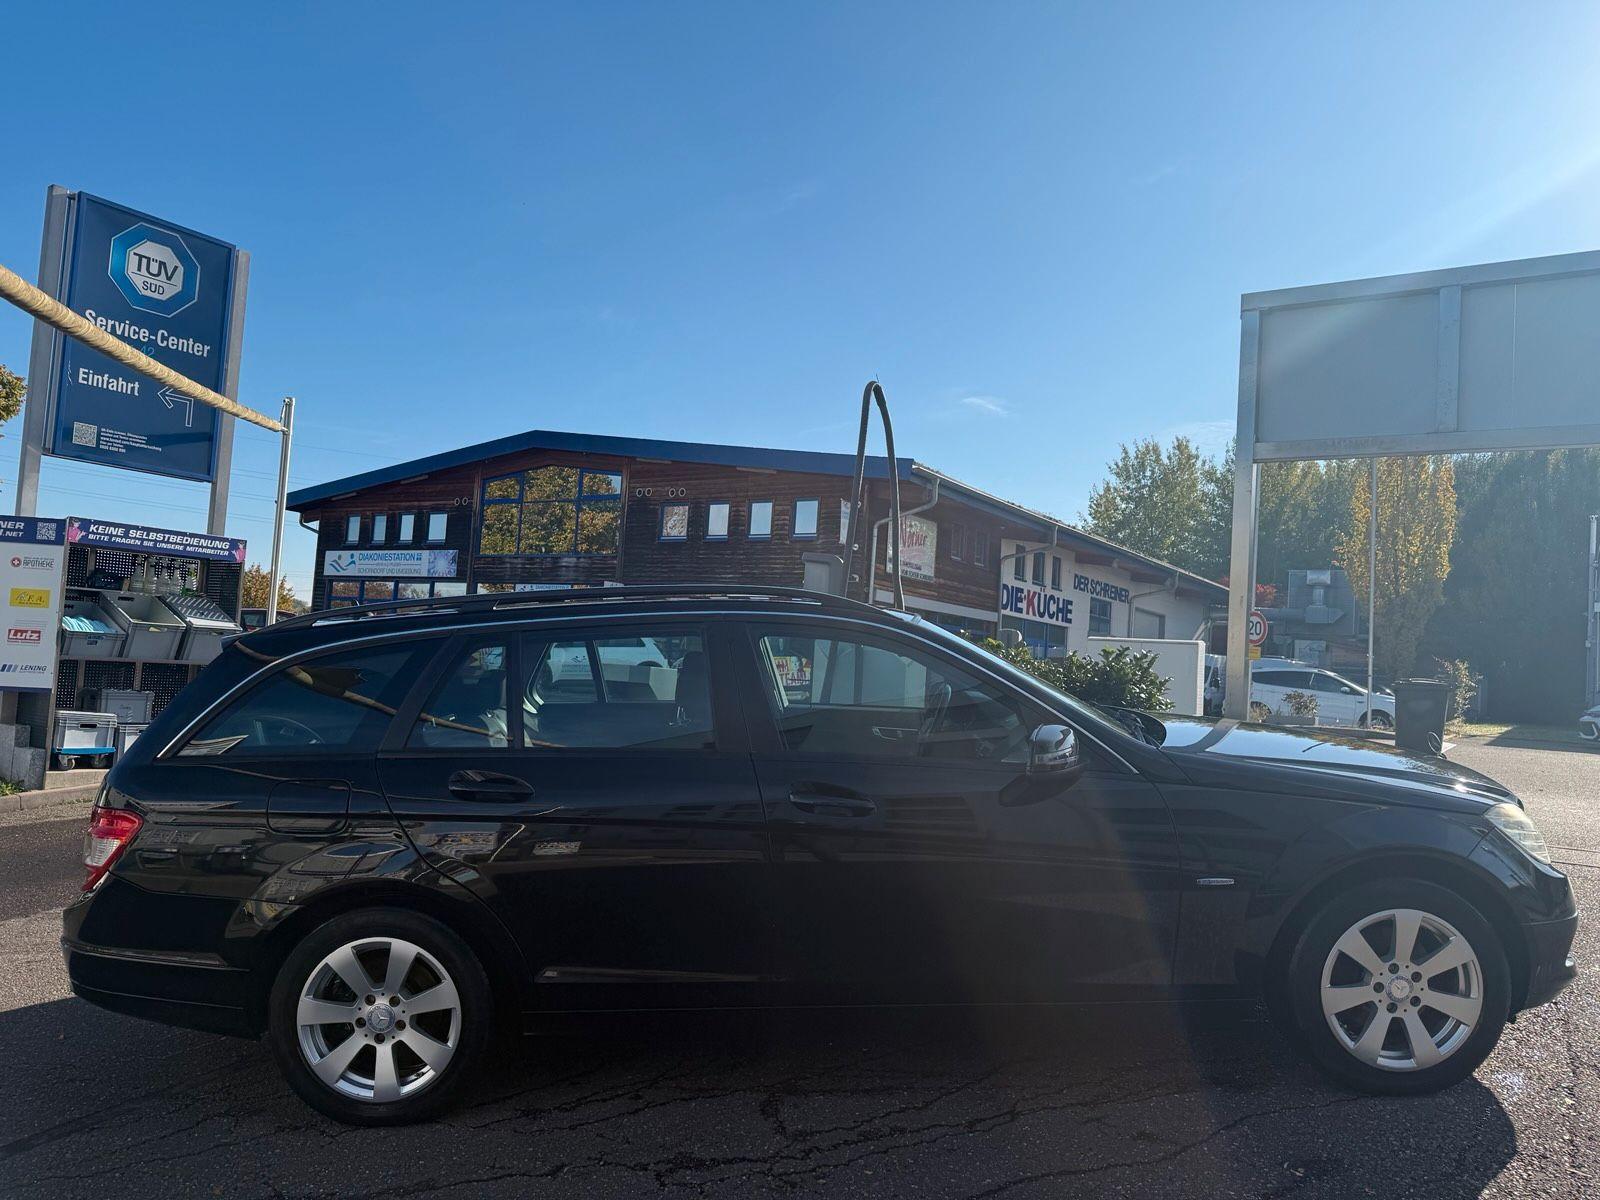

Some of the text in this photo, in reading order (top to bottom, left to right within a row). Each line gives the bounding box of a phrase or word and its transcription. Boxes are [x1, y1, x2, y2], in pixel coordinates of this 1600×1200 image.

[133, 252, 178, 282] TÜV
[141, 280, 165, 295] SÜD
[84, 309, 211, 358] Service-Center
[78, 367, 140, 396] Einfahrt
[89, 524, 230, 550] KEINE SELBSTBEDIENUNG
[111, 536, 141, 545] FRAGEN
[156, 542, 184, 551] UNSERE
[186, 546, 229, 556] MITARBEITER
[22, 559, 55, 568] APOTHEKE
[358, 552, 416, 561] DIAKONIESTATION
[1073, 573, 1129, 604] DER SCHREINER
[1025, 587, 1073, 624] KÜCHE
[9, 629, 40, 640] Lutz
[1249, 621, 1262, 635] 20
[20, 664, 47, 672] LENING
